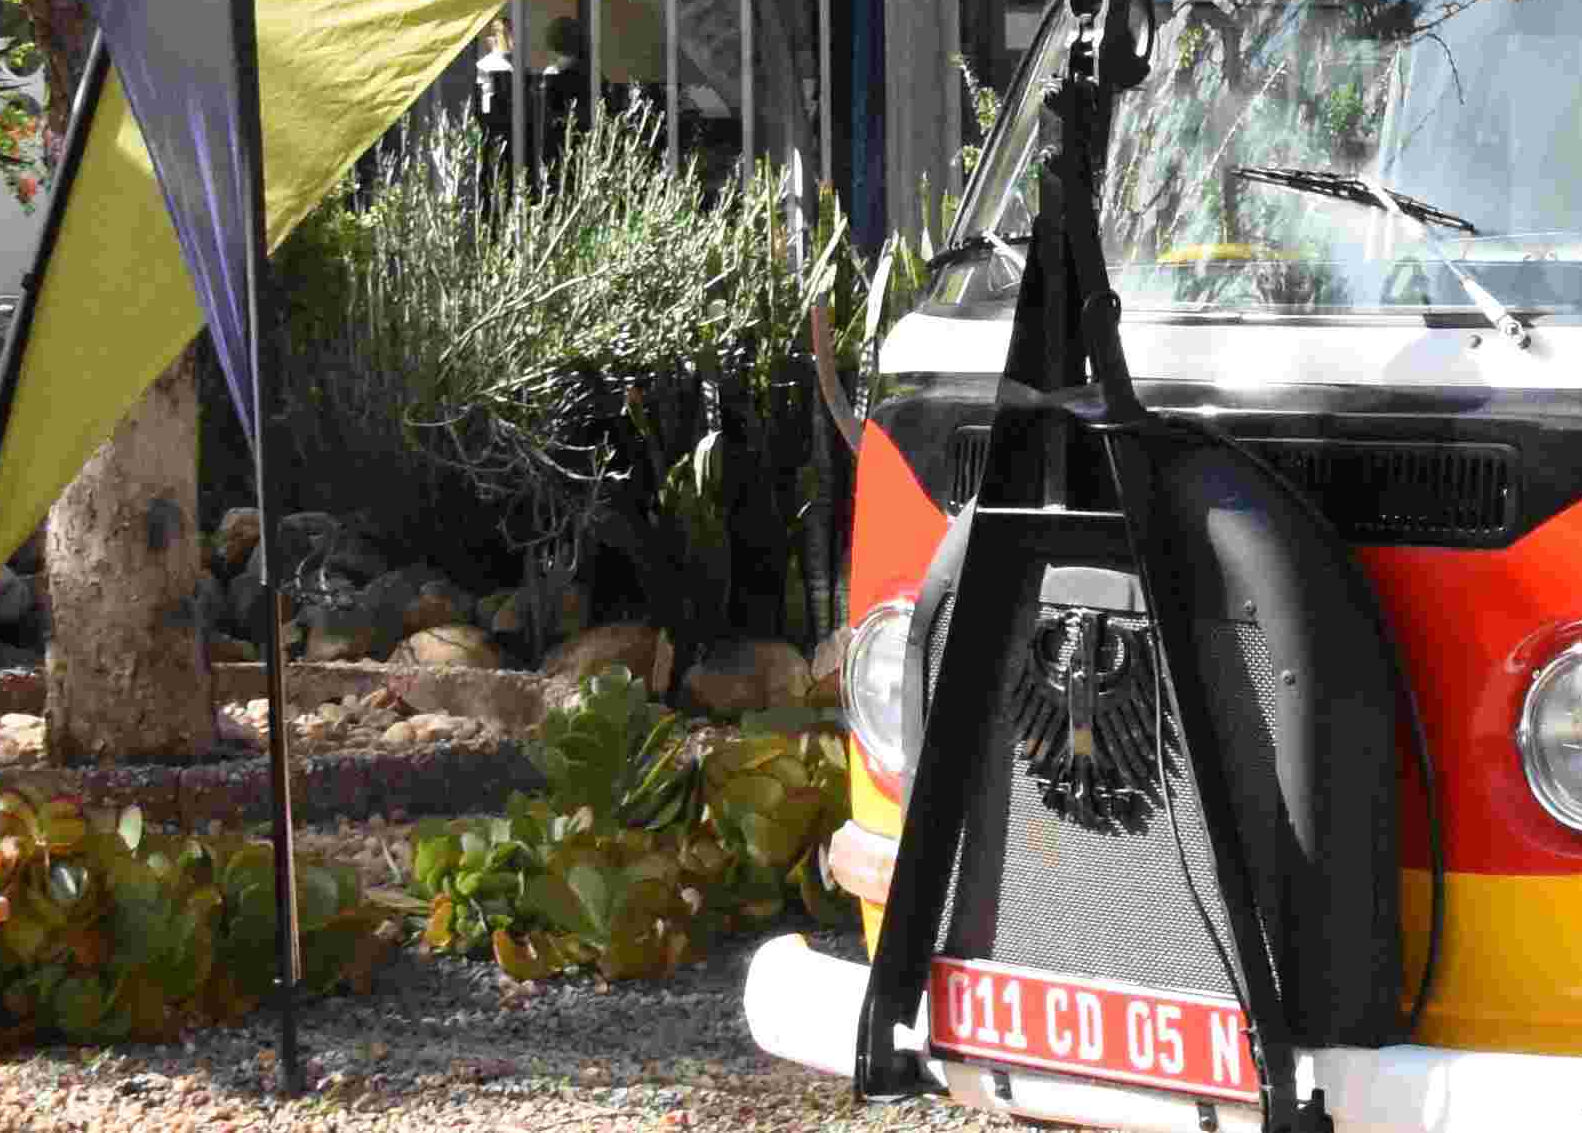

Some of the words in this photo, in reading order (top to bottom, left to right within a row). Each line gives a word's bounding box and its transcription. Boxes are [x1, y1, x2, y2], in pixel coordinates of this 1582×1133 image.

[946, 971, 1028, 1051] 011
[1043, 986, 1105, 1062] CD
[1126, 1000, 1185, 1075] 05
[1208, 1011, 1243, 1086] N
